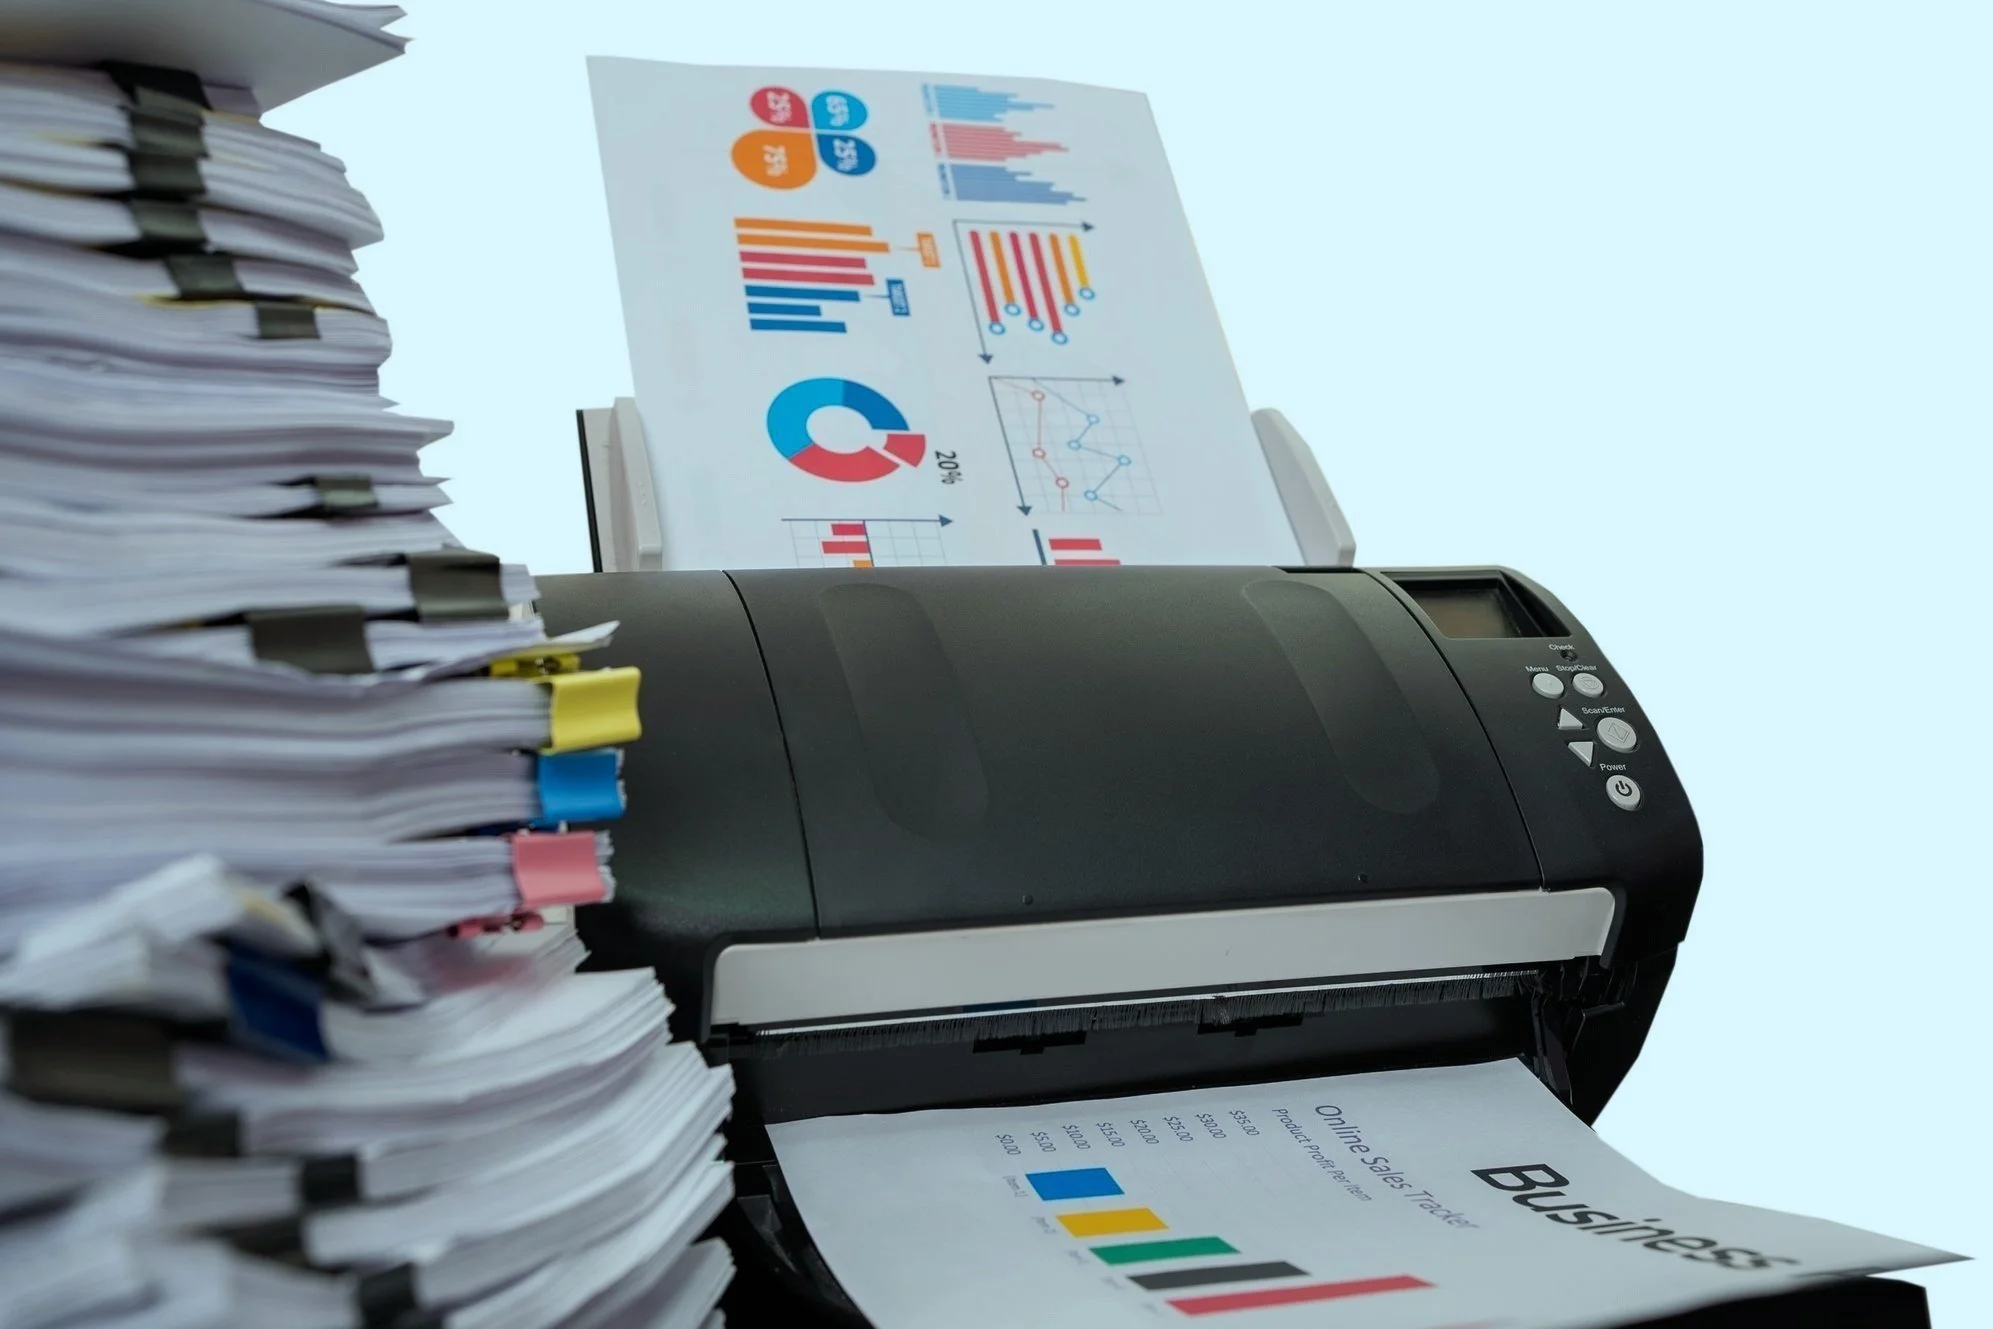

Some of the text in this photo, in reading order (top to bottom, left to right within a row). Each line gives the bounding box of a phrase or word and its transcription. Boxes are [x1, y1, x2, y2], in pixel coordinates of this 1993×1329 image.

[766, 91, 792, 124] 25%
[833, 138, 858, 171] 25%
[935, 450, 963, 484] 20%
[1556, 664, 1597, 672] Stop/Clear
[1600, 763, 1626, 771] Power
[1096, 1121, 1126, 1148] $15.00
[1130, 1119, 1160, 1145] $20.00
[1162, 1116, 1194, 1142] $25.00
[1195, 1113, 1227, 1139] $30.00
[1229, 1109, 1260, 1136] $35.00
[994, 1133, 1022, 1156] $0.00
[1030, 1131, 1056, 1153] $5.00
[1061, 1124, 1091, 1150] $10.00
[1271, 1108, 1372, 1202] Product Profit Per Item
[1315, 1105, 1480, 1229] Online Sales Tracker
[1470, 1163, 1800, 1272] Business
